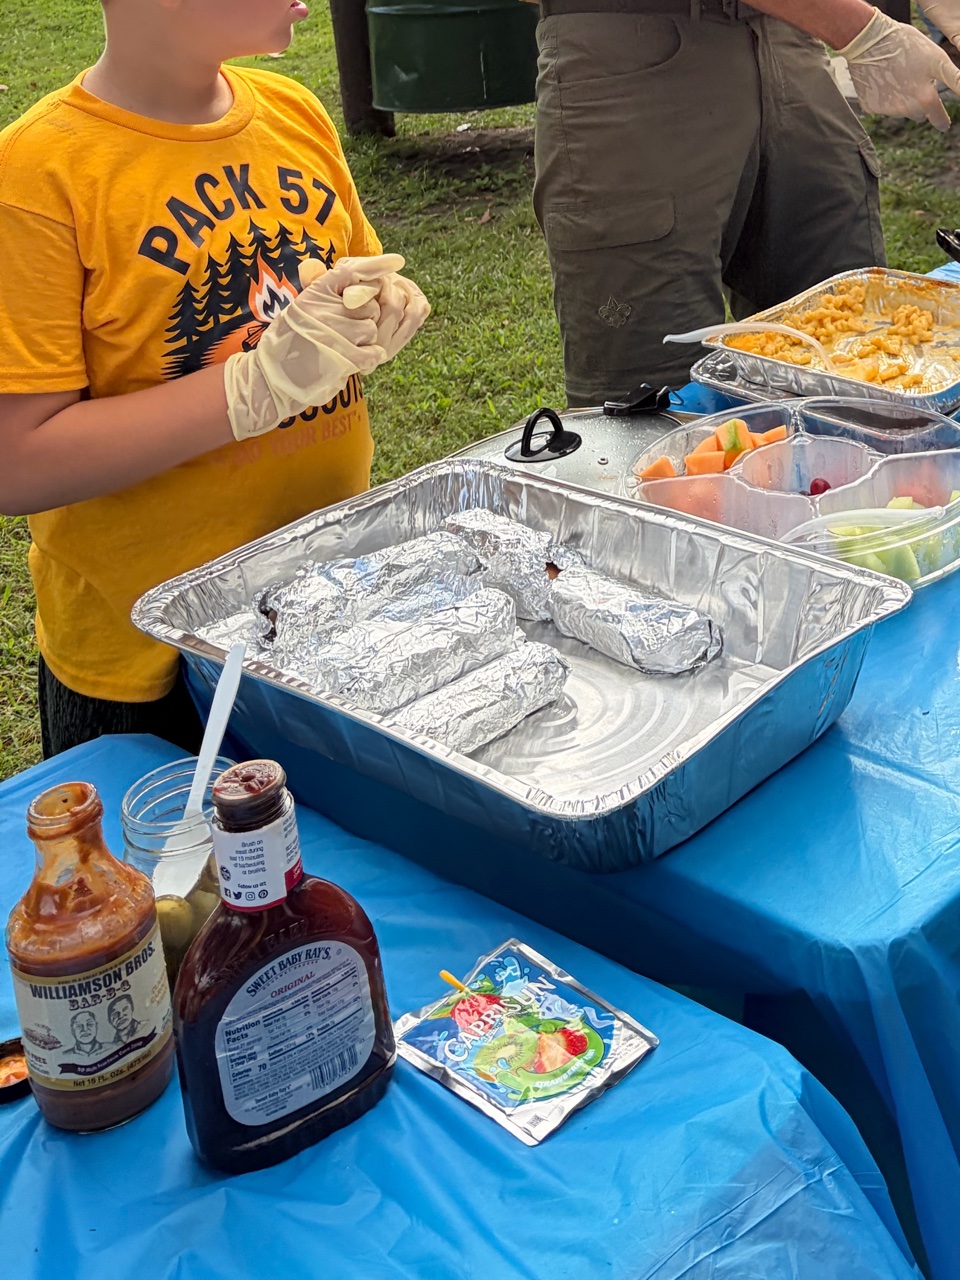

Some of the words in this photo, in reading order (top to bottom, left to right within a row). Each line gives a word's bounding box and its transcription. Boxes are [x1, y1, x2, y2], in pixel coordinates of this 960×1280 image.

[138, 163, 267, 276] PACK
[276, 165, 336, 226] 57
[246, 966, 279, 998] SWEET
[278, 950, 304, 971] BABY
[305, 946, 331, 961] RAY'S
[30, 967, 122, 1000] WILLIAMSON
[270, 971, 317, 999] ORIGINAL
[225, 1020, 260, 1037] Nutrition
[226, 1033, 249, 1045] Facts
[258, 1063, 267, 1072] 70
[73, 1079, 85, 1087] Net
